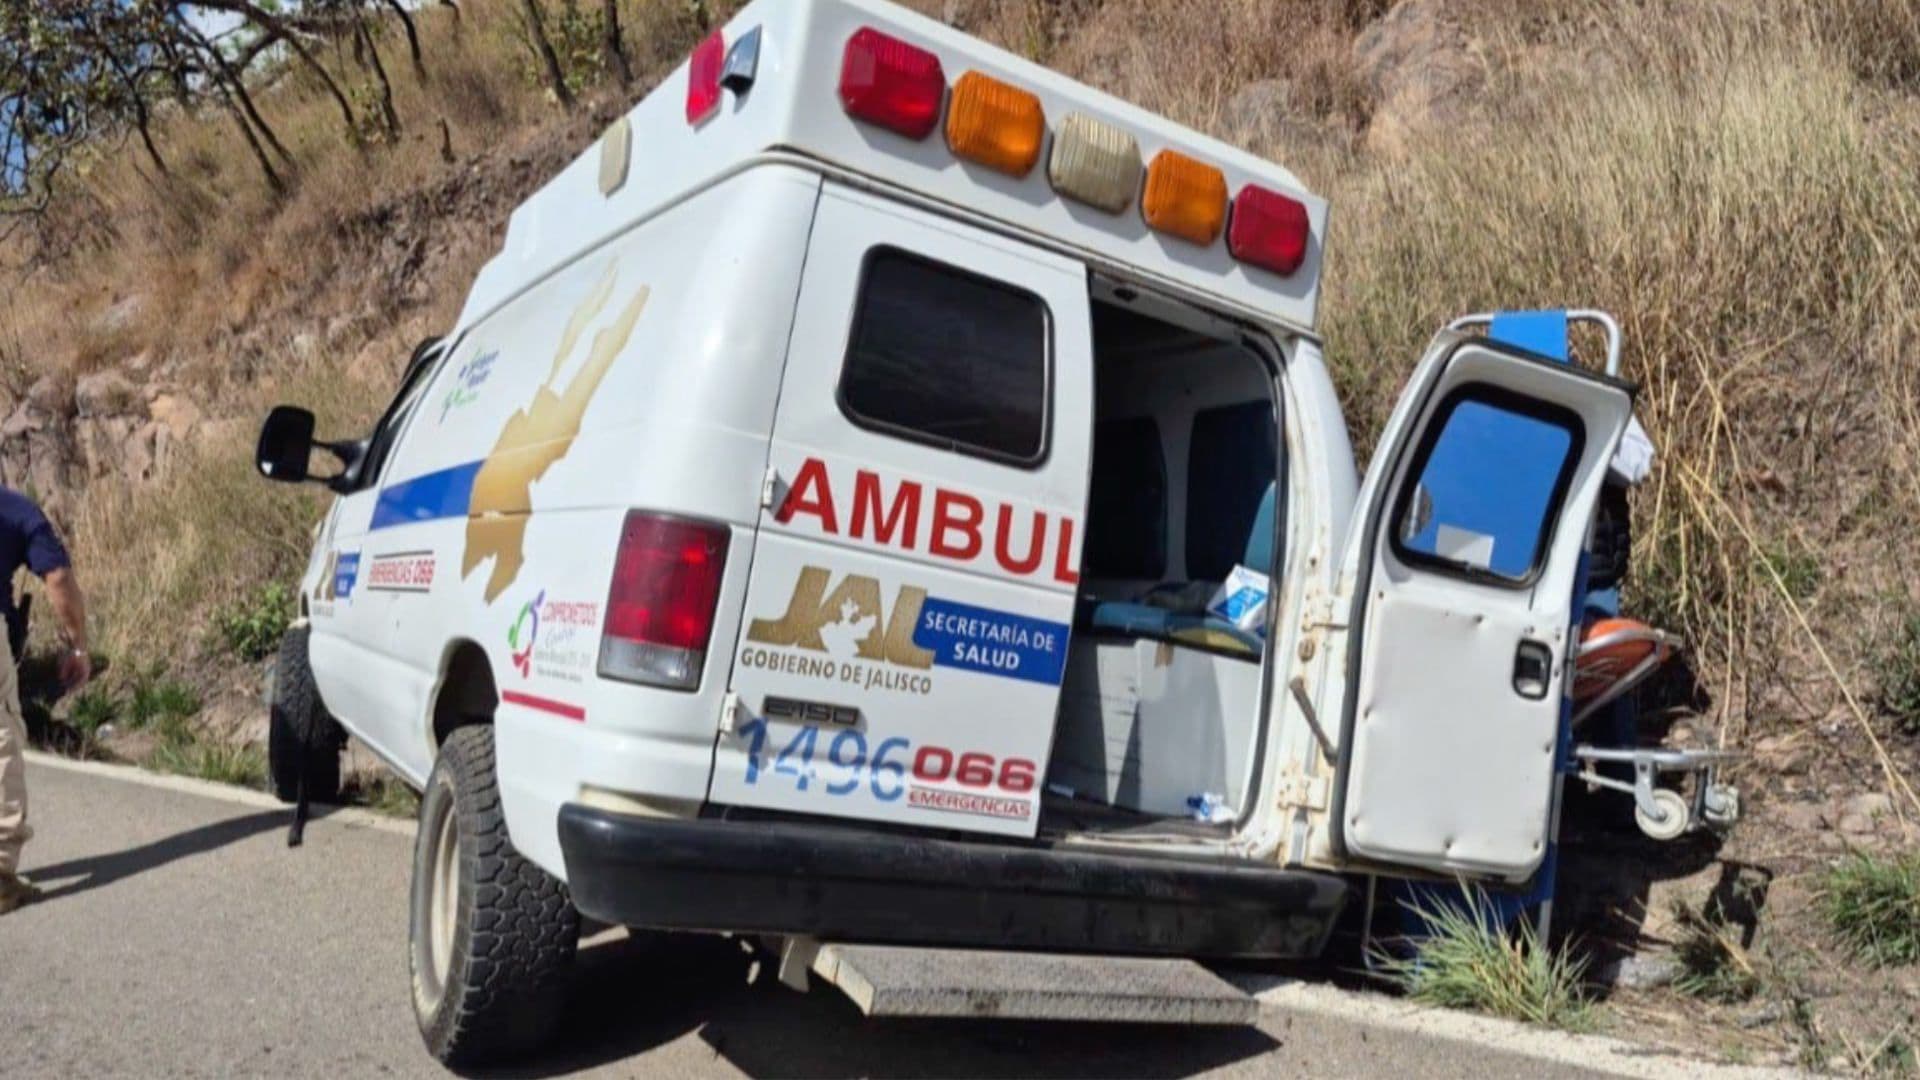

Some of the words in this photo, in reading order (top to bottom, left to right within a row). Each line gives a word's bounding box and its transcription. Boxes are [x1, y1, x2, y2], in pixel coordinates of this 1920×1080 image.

[774, 457, 1080, 585] AMBUL
[924, 611, 1028, 646] SECRETARÍA
[1032, 631, 1056, 651] DE
[740, 648, 835, 680] GOBIERNO
[839, 664, 861, 683] DE
[864, 666, 932, 694] JALISCO
[952, 643, 1021, 671] SALUD
[738, 716, 910, 803] 1496
[911, 745, 1036, 793] 066
[908, 791, 1031, 817] EMERGENCIAS
